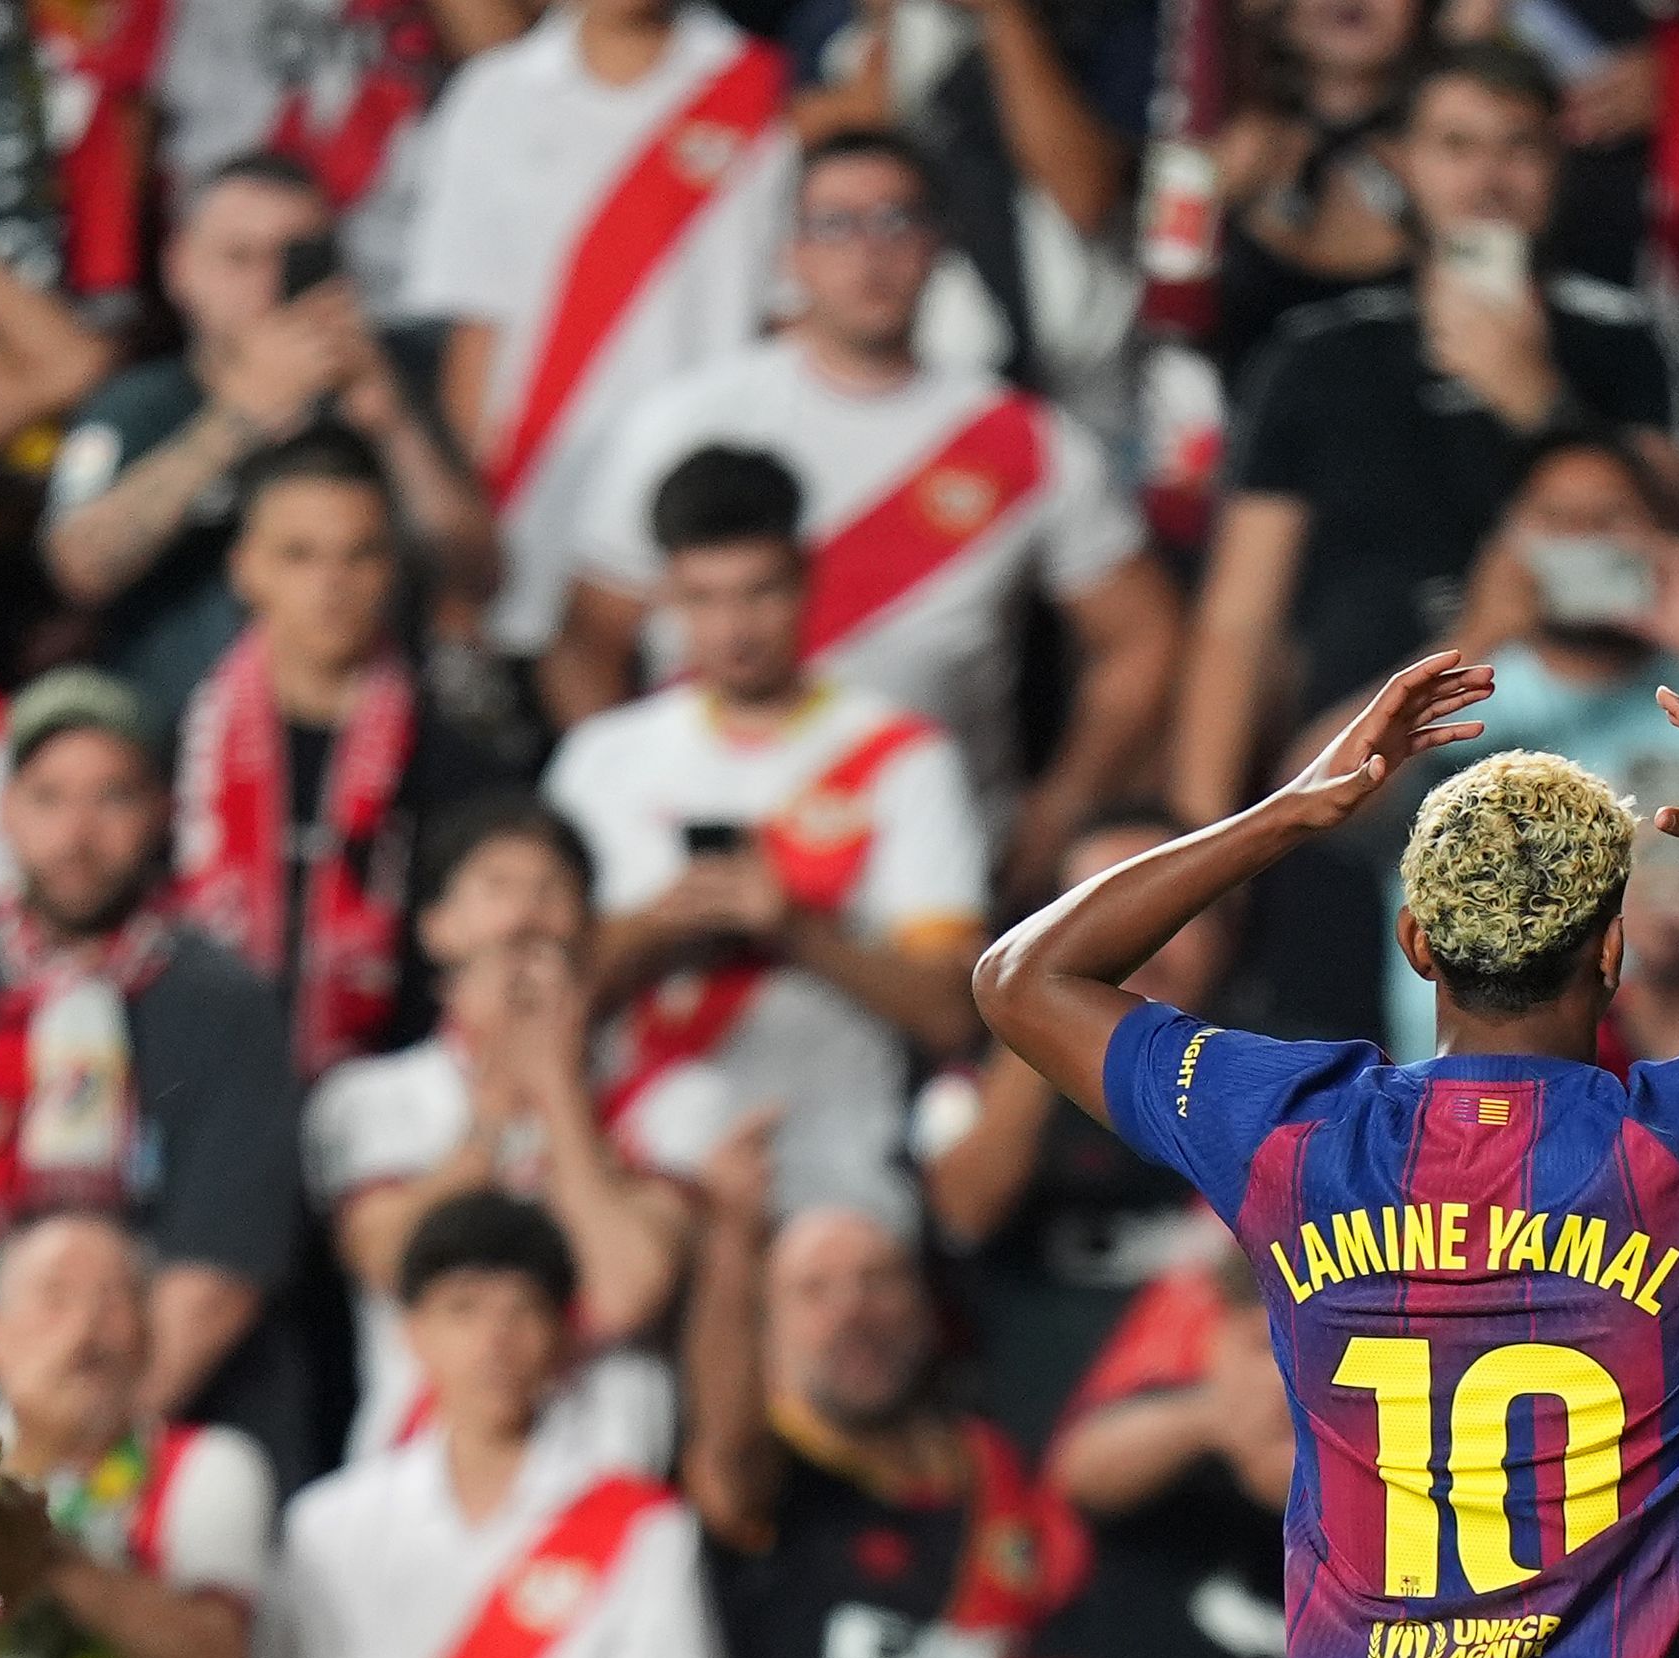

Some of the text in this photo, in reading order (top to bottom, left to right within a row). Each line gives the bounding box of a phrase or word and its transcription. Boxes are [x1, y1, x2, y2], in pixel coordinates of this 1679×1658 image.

[1177, 1028, 1226, 1089] LIGHT
[1271, 1202, 1469, 1304] LAMINE
[1332, 1337, 1627, 1598] 10
